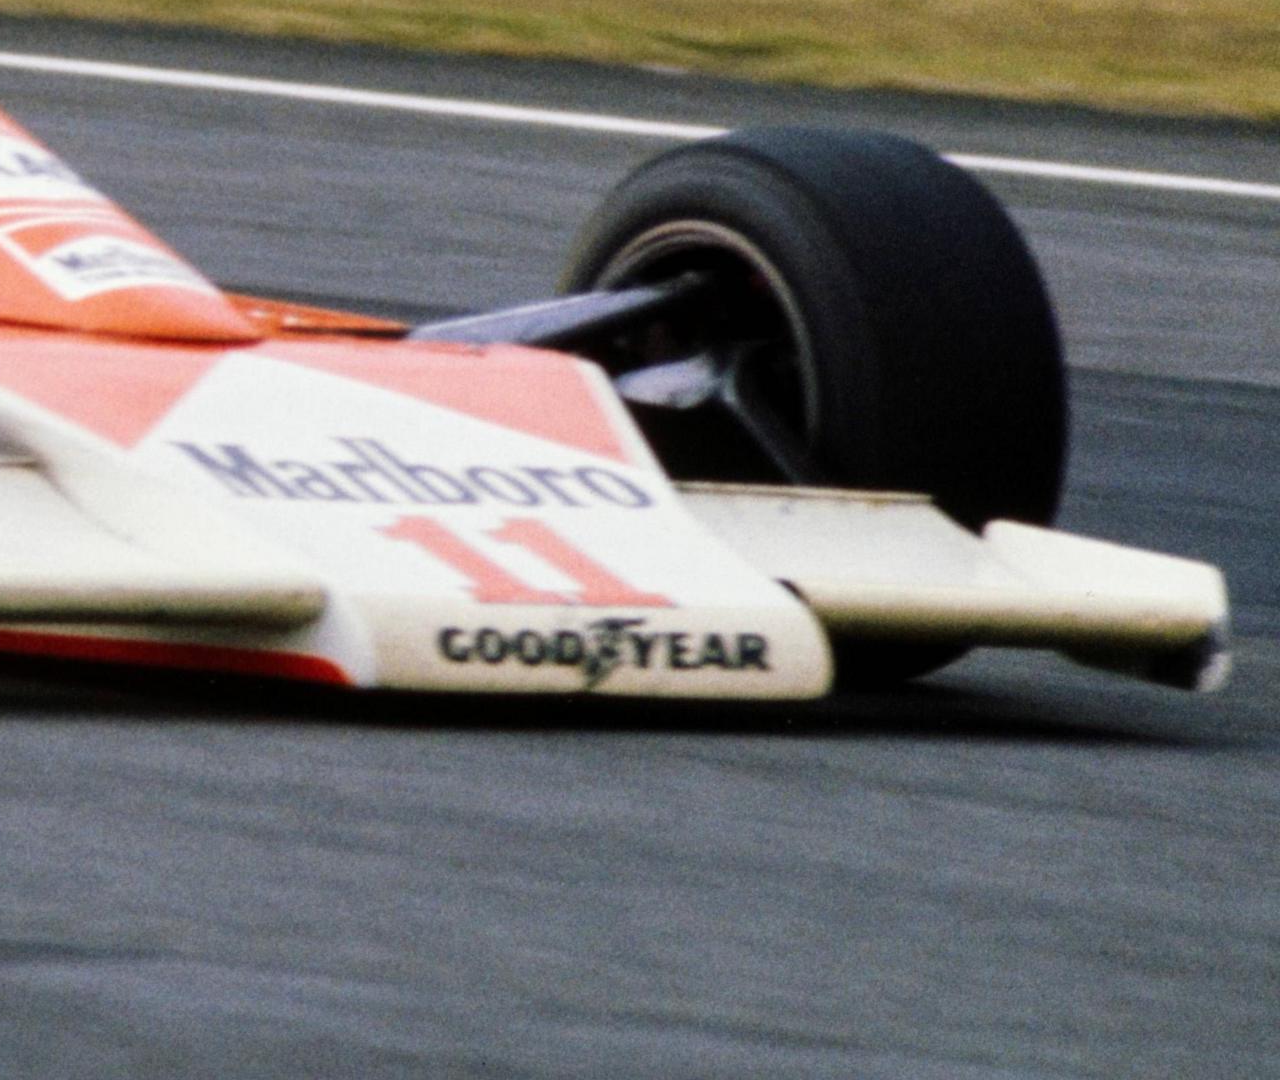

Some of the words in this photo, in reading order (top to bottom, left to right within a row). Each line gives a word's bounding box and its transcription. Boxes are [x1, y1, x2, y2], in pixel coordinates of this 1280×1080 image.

[171, 437, 656, 510] Marlboro
[372, 515, 678, 608] 11
[438, 623, 772, 673] GOODYEAR
